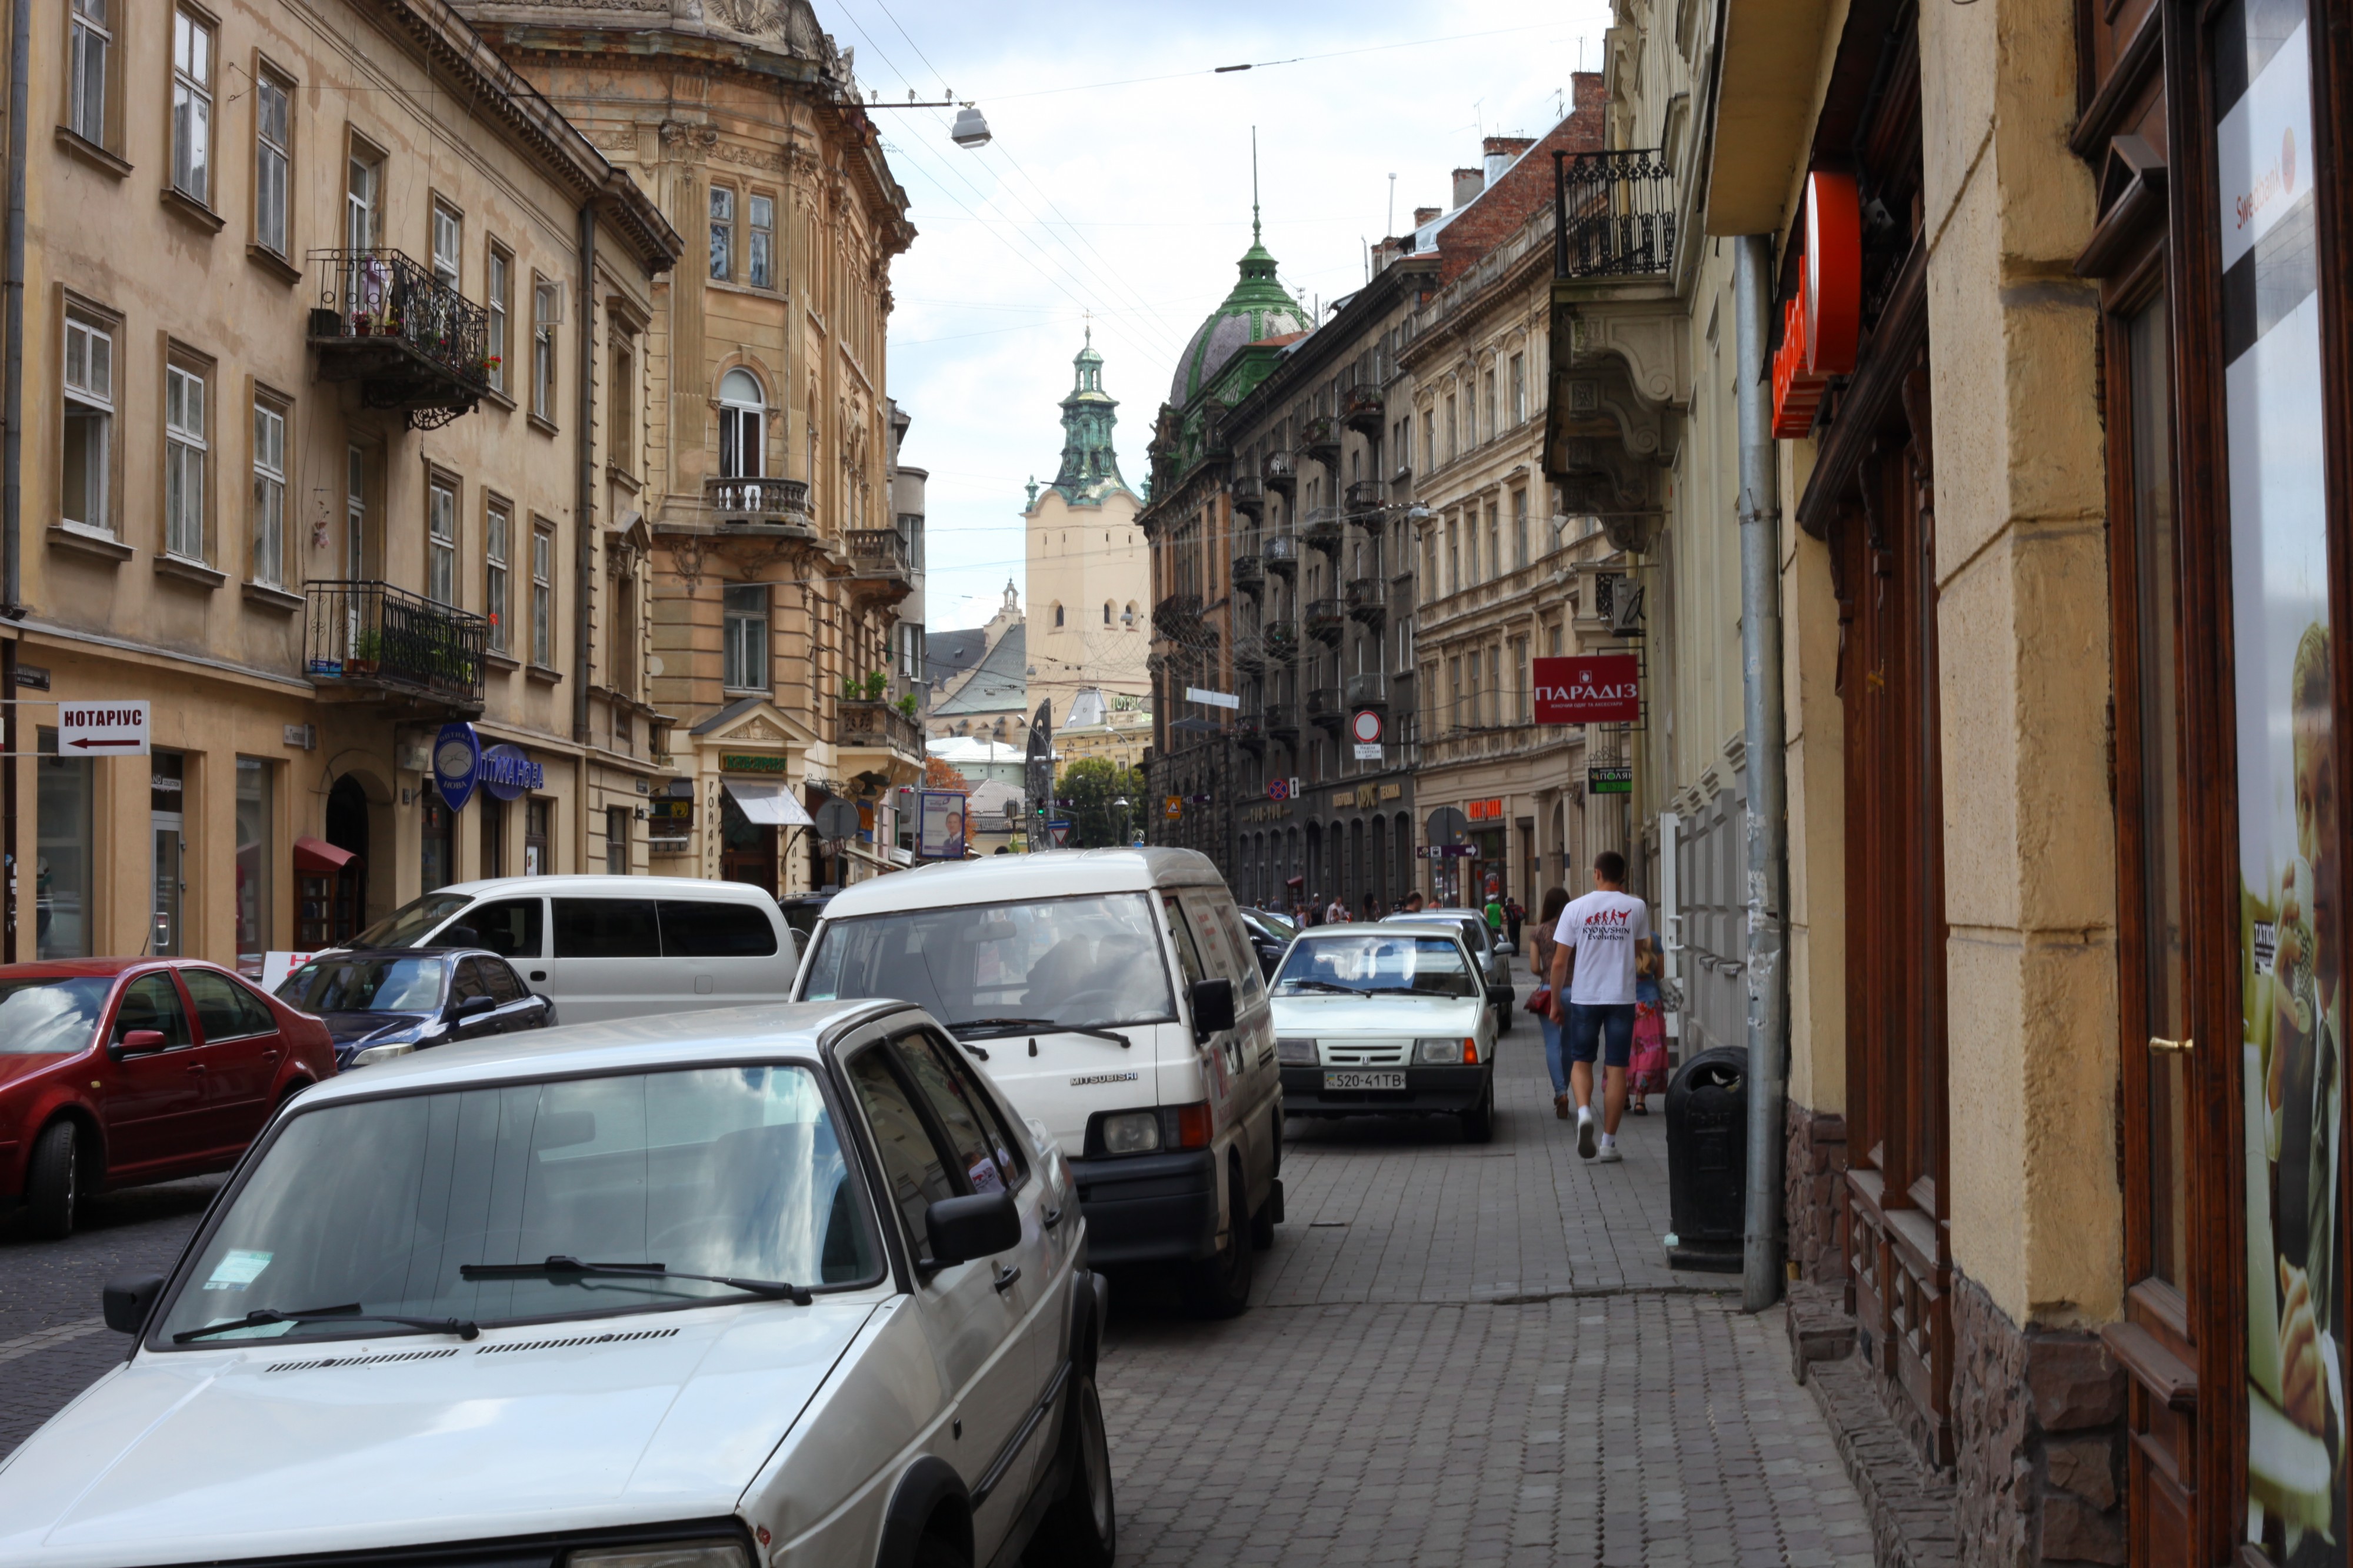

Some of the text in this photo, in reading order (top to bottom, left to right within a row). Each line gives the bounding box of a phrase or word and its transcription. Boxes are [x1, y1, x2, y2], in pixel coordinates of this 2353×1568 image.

[2237, 156, 2281, 230] Swedbank
[1535, 683, 1638, 701] ПАРАДІЗ
[64, 709, 142, 727] НОТАРІУС
[439, 732, 471, 742] ОПТИКА
[479, 752, 544, 789] ПТИКА НОВА
[443, 780, 467, 790] НОВА
[1380, 783, 1401, 800] ТЕХНІКА
[1357, 782, 1378, 809] ОРУС
[1071, 1072, 1138, 1086] MITSUBISHI
